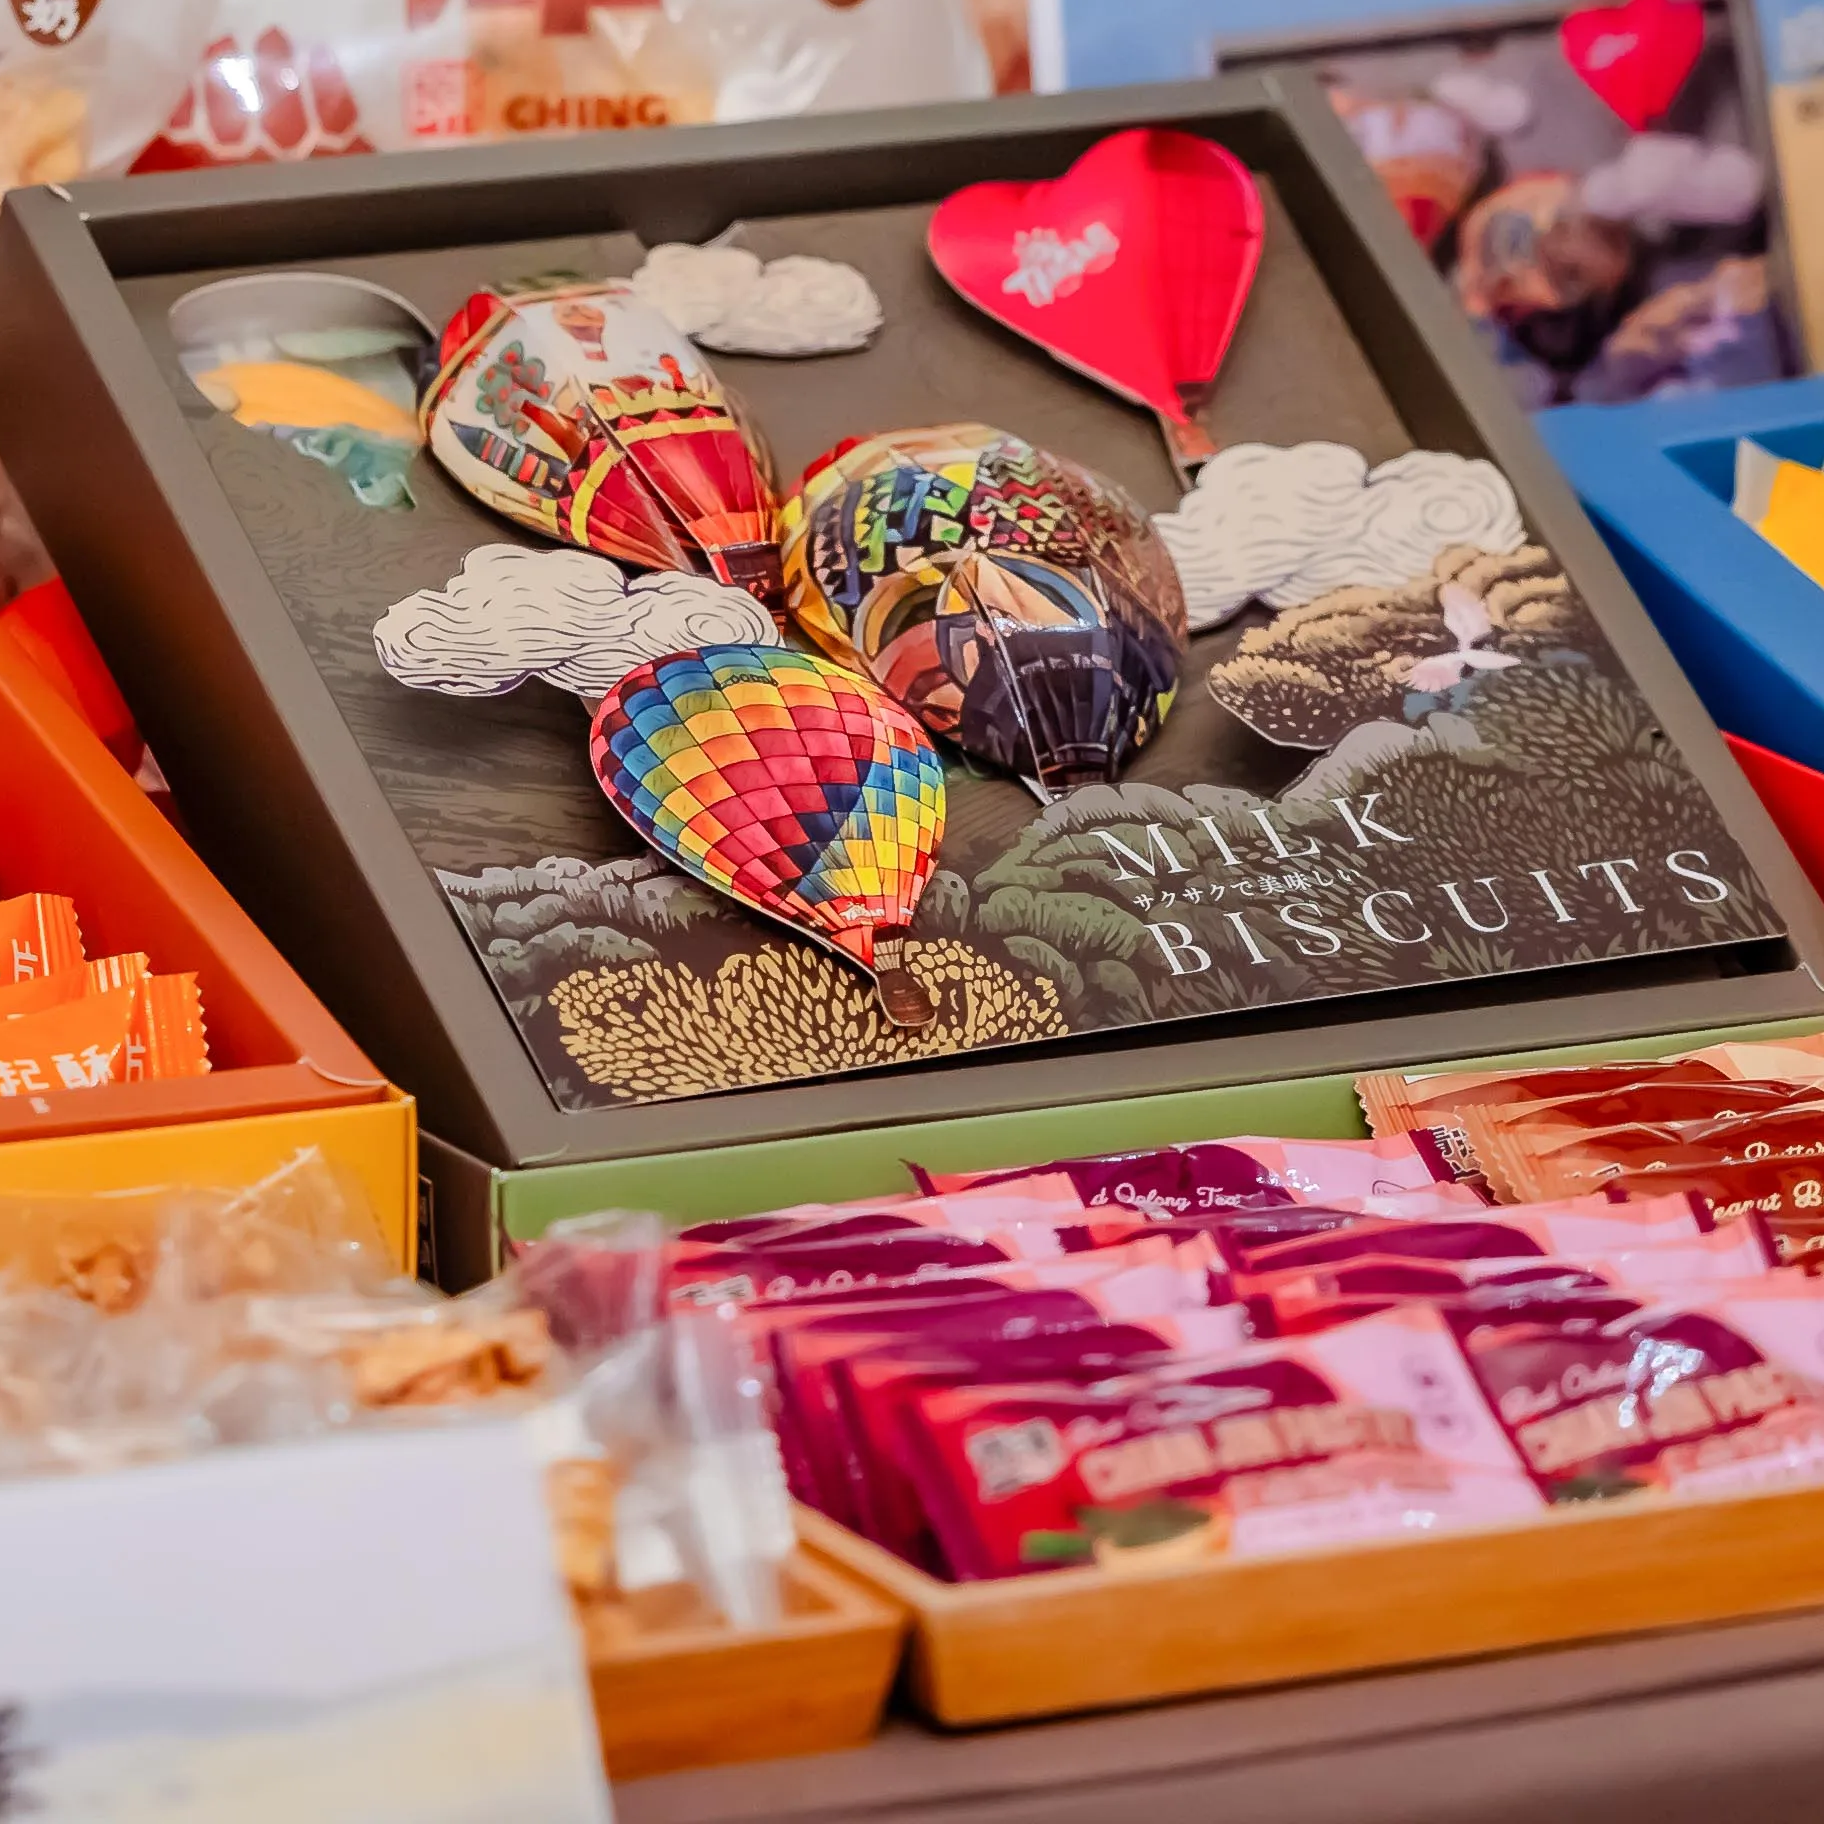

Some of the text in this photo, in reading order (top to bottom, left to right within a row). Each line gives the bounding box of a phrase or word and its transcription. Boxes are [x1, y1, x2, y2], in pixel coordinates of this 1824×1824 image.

[500, 92, 670, 132] CHING
[1089, 791, 1414, 883] MILK
[1132, 866, 1364, 913] サクサクで美味しい
[1143, 849, 1730, 977] BISCUITS
[1114, 1182, 1191, 1211] Oolong
[1196, 1186, 1242, 1208] Tea
